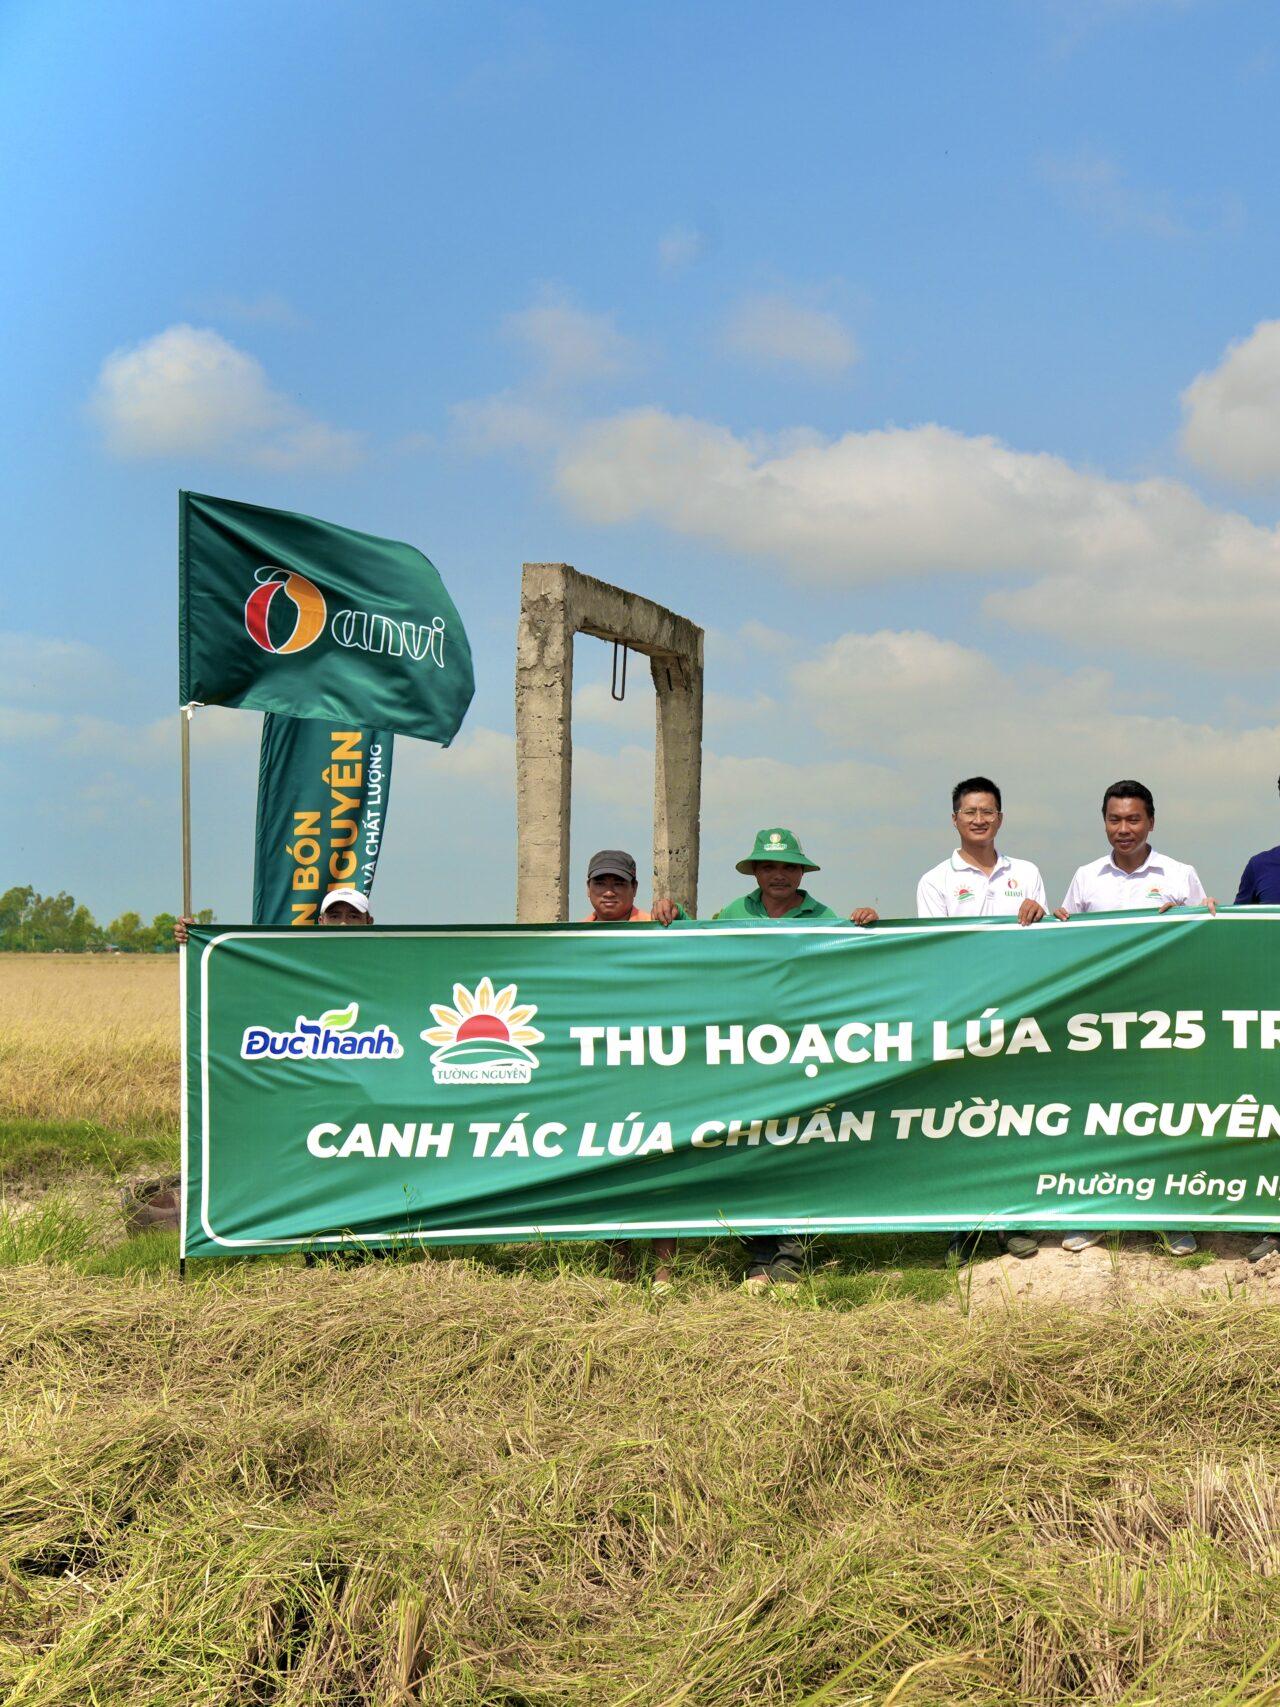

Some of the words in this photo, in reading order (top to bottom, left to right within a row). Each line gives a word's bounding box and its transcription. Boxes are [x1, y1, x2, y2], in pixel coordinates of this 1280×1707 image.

[331, 609, 446, 668] anvi
[366, 744, 386, 804] LƯỢNG
[286, 811, 321, 890] BÓN
[362, 810, 381, 856] CHẤT
[570, 1026, 686, 1066] THU
[705, 1021, 913, 1078] HOẠCH
[932, 1008, 1052, 1061] LÚA
[1066, 1010, 1206, 1051] ST25
[437, 1067, 478, 1079] TƯỜNG
[481, 1067, 527, 1079] NGUYÊN
[306, 1122, 454, 1158] CANH
[468, 1112, 567, 1158] TÁC
[577, 1112, 674, 1157] LÚA
[690, 1103, 878, 1149] CHUẨN
[890, 1097, 1072, 1140] TƯỜNG
[1036, 1171, 1155, 1201] Phường
[1165, 1170, 1246, 1202] Hồng
